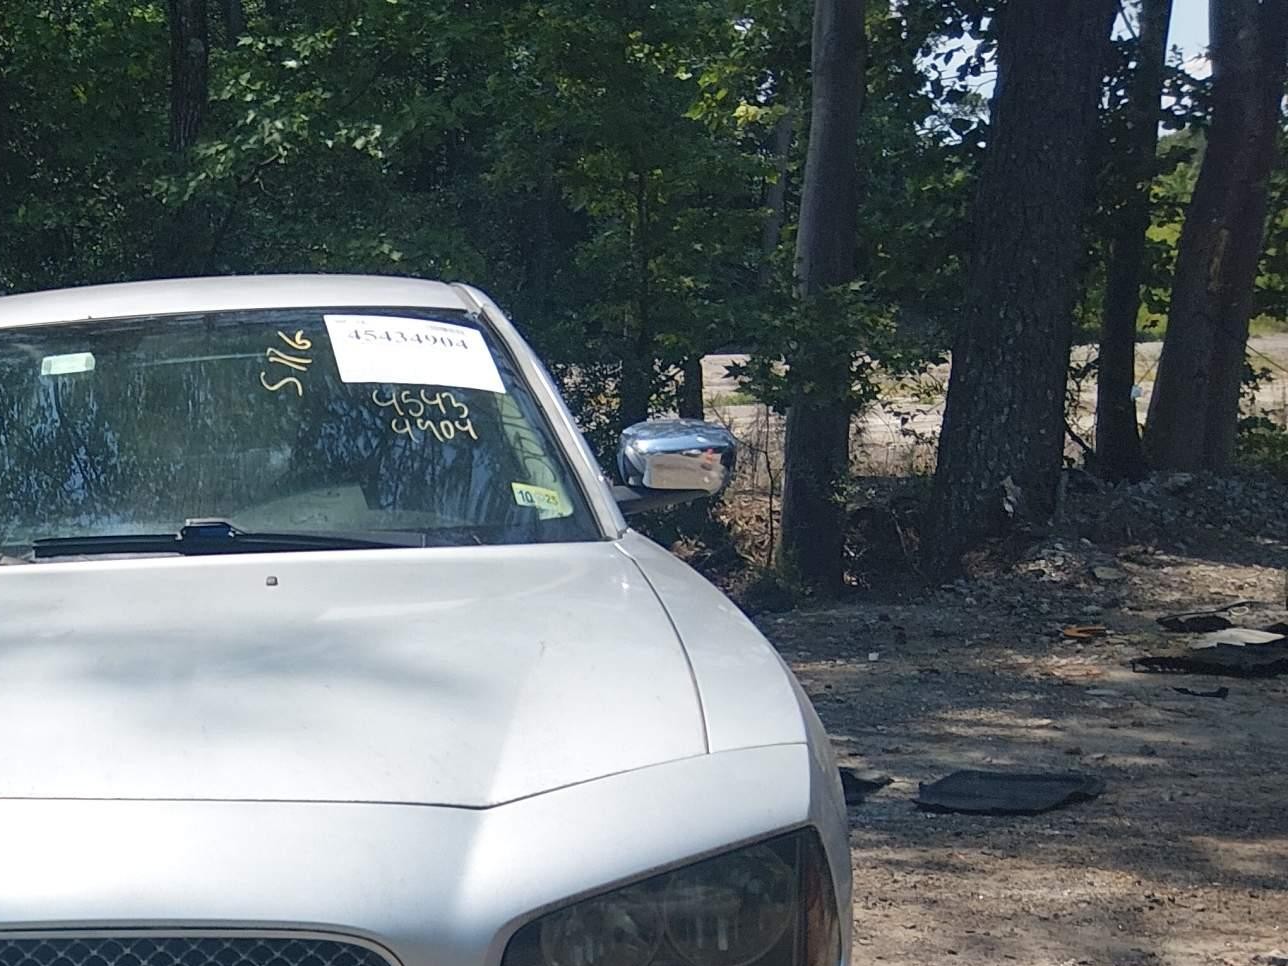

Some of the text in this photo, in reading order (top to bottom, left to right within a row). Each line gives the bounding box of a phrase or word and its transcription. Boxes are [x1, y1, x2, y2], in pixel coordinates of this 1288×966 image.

[348, 328, 469, 350] 45434904
[372, 389, 469, 418] 4543
[391, 418, 478, 443] 4904
[518, 490, 534, 503] 10
